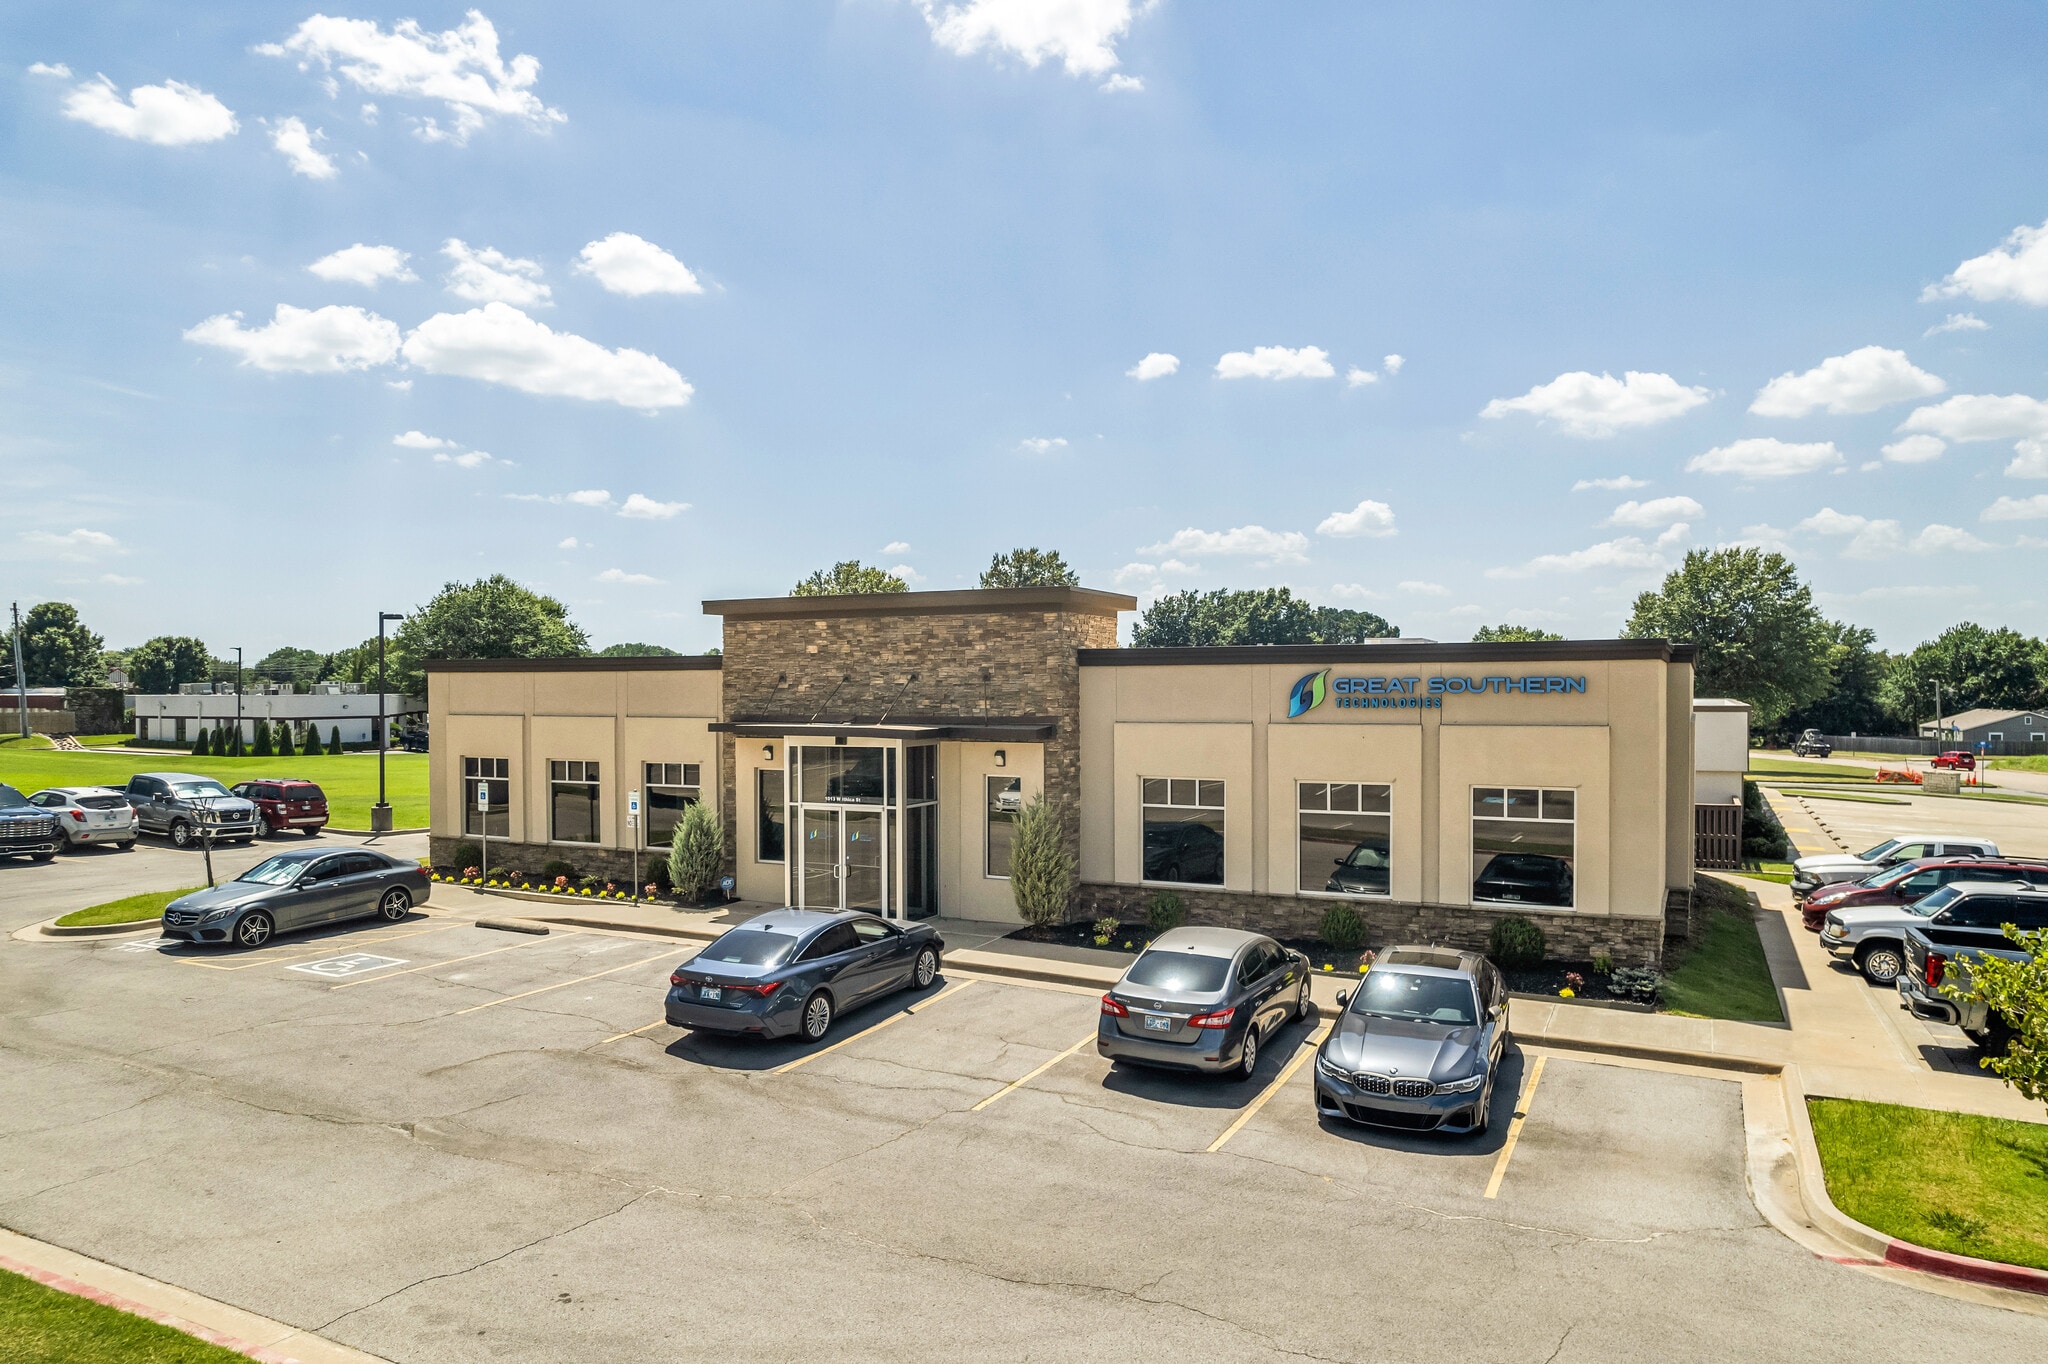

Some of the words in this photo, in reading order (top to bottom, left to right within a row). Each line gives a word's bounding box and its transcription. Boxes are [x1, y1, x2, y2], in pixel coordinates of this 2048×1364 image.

[1332, 678, 1420, 694] GREAT
[1427, 676, 1586, 694] SOUTHERN
[1335, 697, 1442, 709] TECHNOLOGIES
